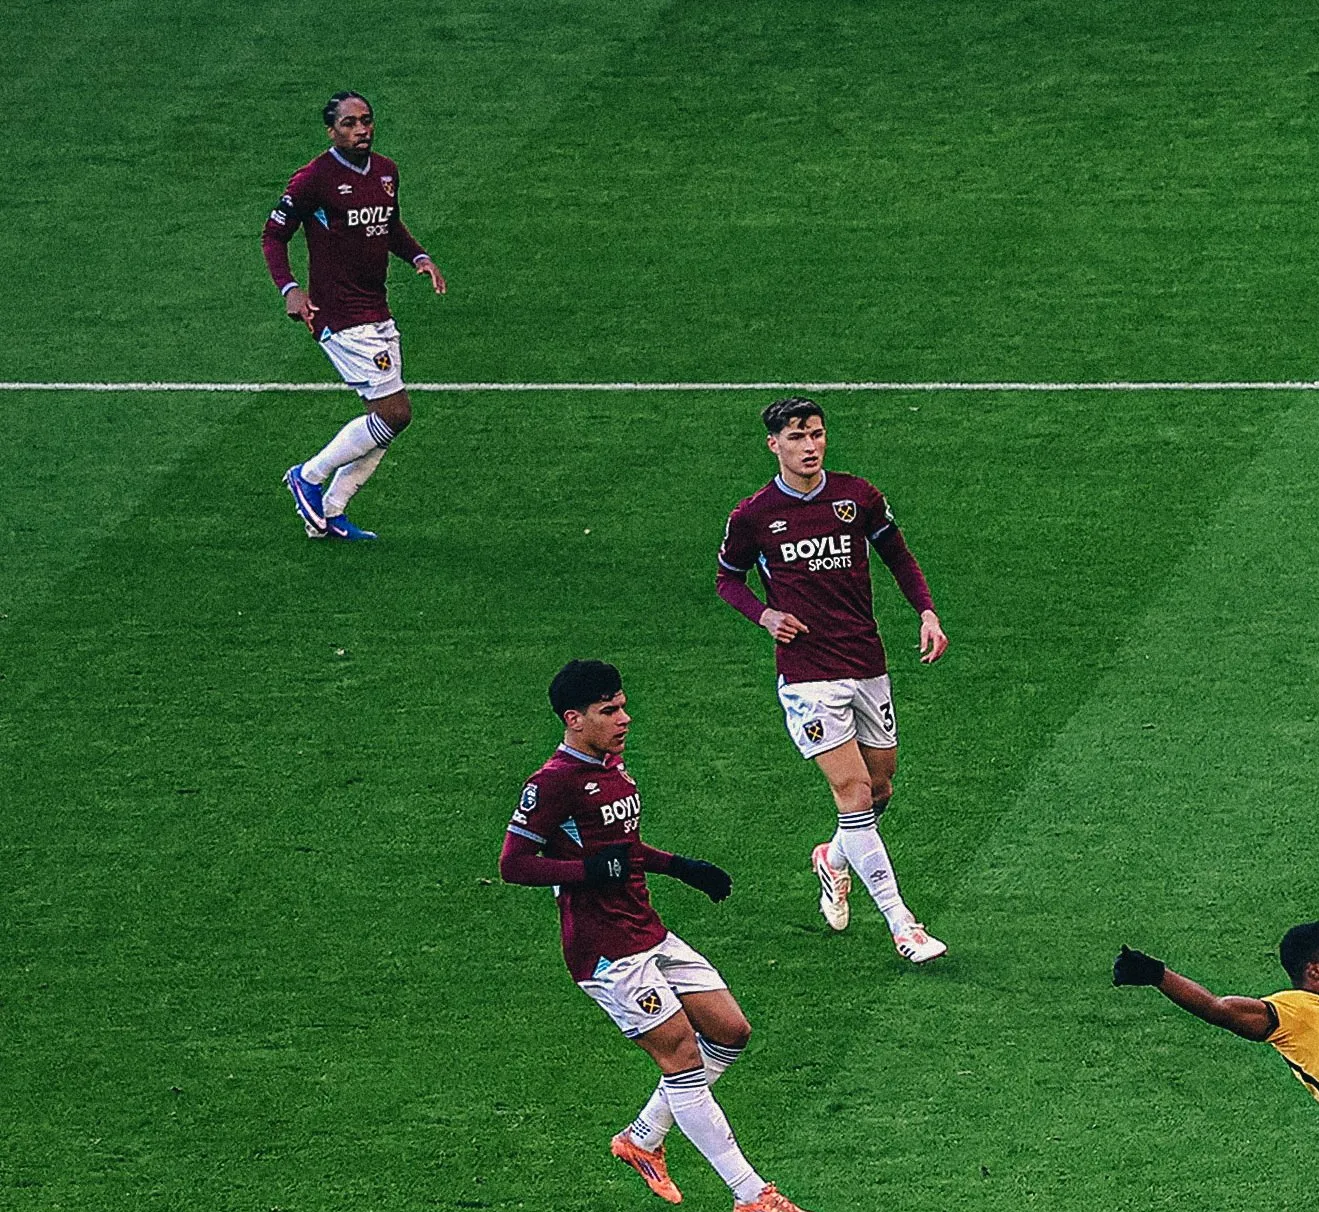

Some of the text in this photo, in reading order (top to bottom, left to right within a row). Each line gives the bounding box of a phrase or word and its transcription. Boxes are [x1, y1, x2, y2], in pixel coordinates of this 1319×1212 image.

[780, 534, 852, 562] BOYLE
[808, 555, 852, 572] SPORTS
[600, 793, 641, 826] BOYL
